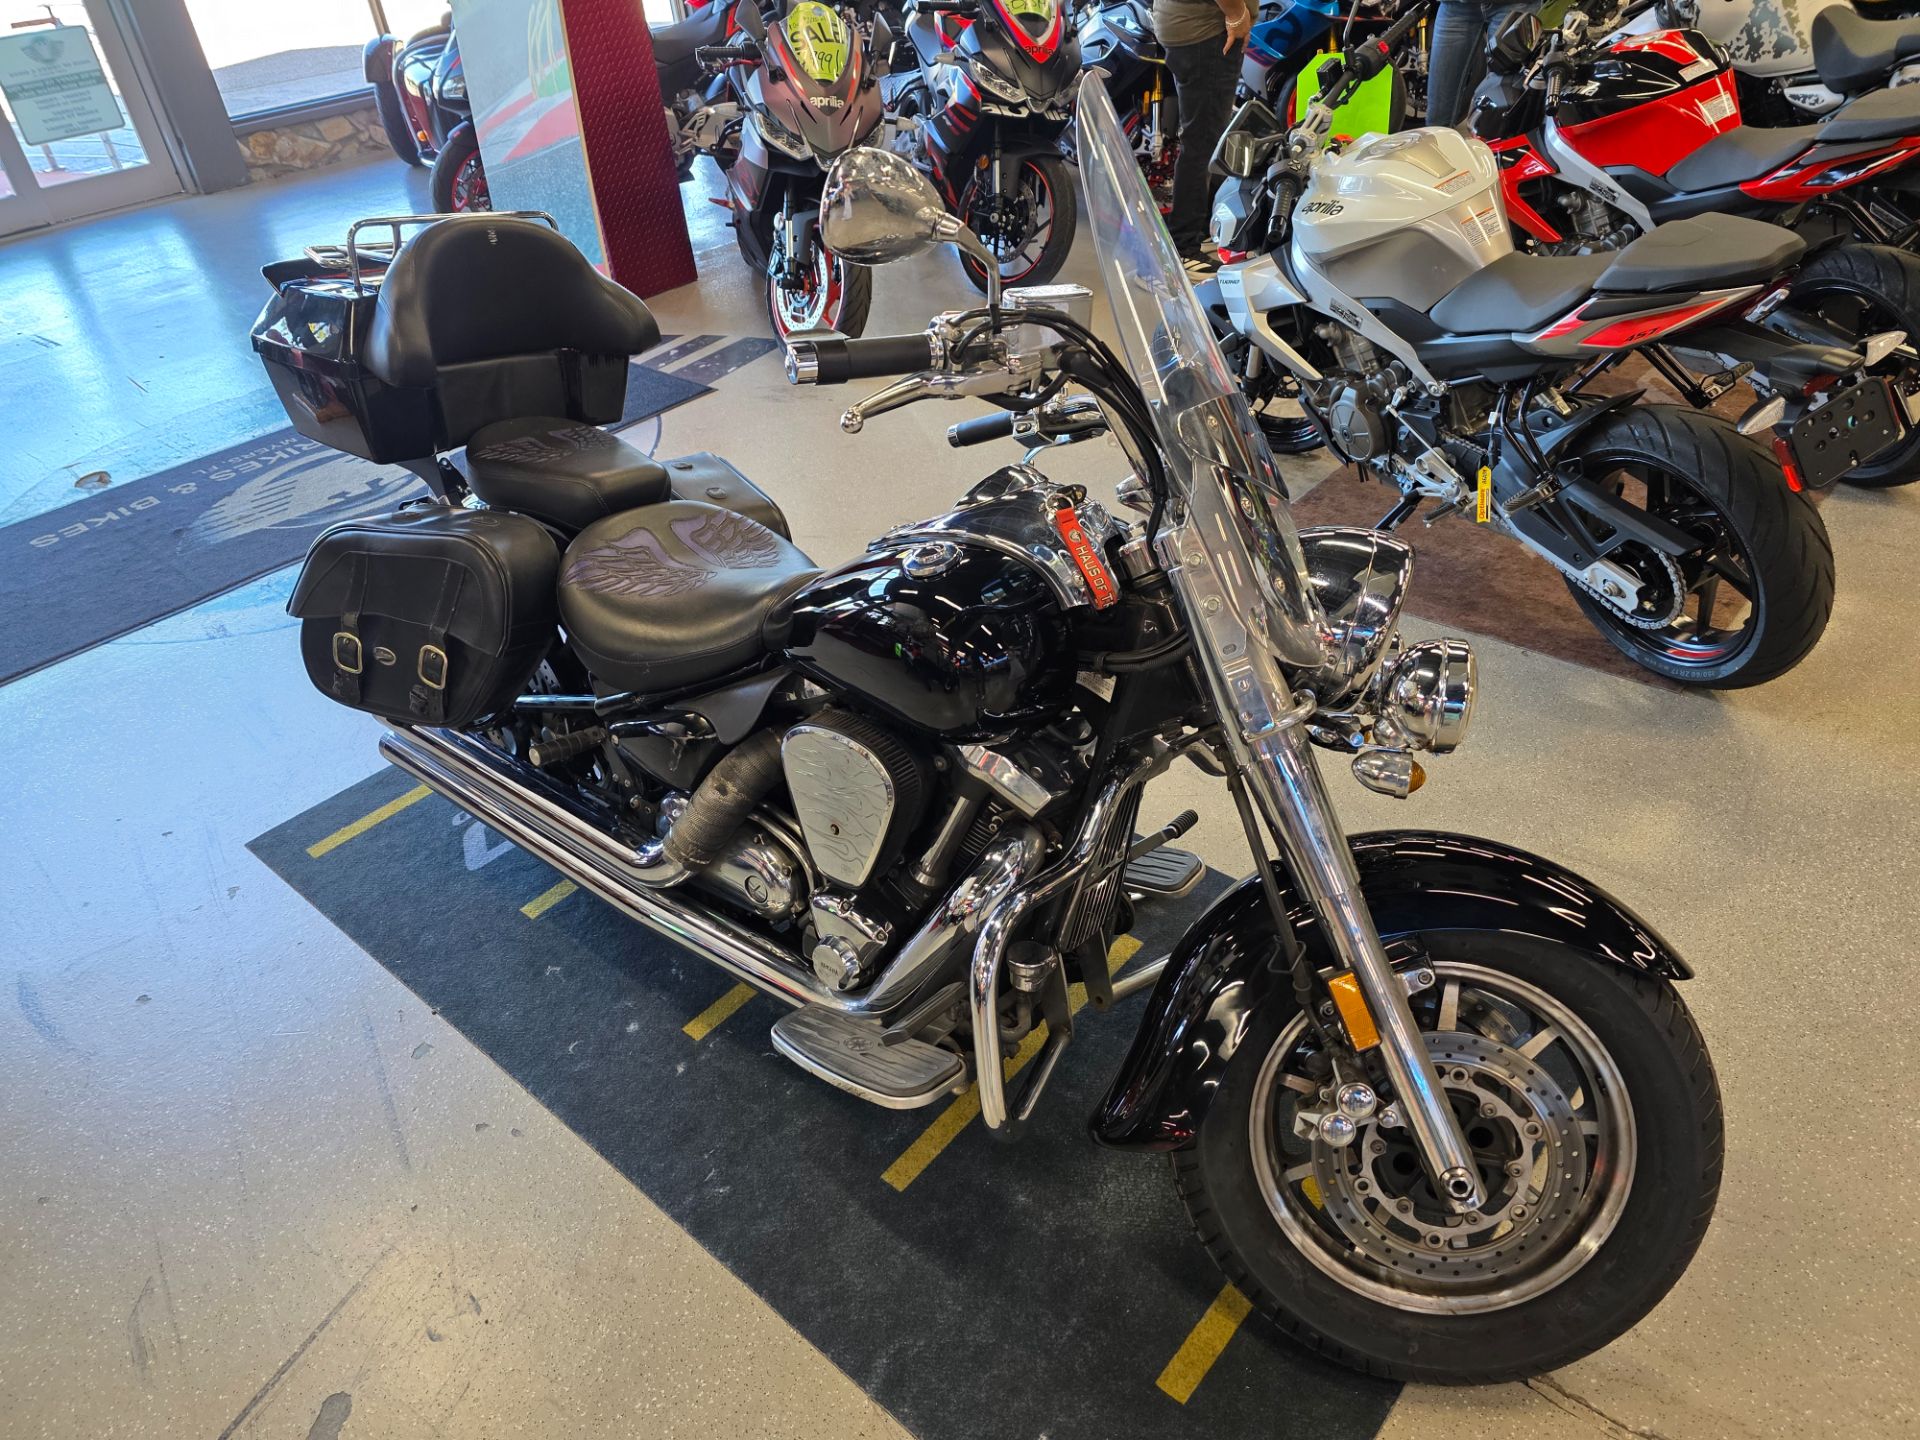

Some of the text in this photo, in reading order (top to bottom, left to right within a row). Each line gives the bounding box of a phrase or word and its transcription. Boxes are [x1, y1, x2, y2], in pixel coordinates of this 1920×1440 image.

[810, 95, 845, 108] aprilia
[1301, 199, 1344, 216] aprilia
[1624, 327, 1661, 342] 457
[29, 440, 322, 548] RIKES & BIKES
[1076, 545, 1101, 577] HAUS
[1093, 577, 1108, 592] OF
